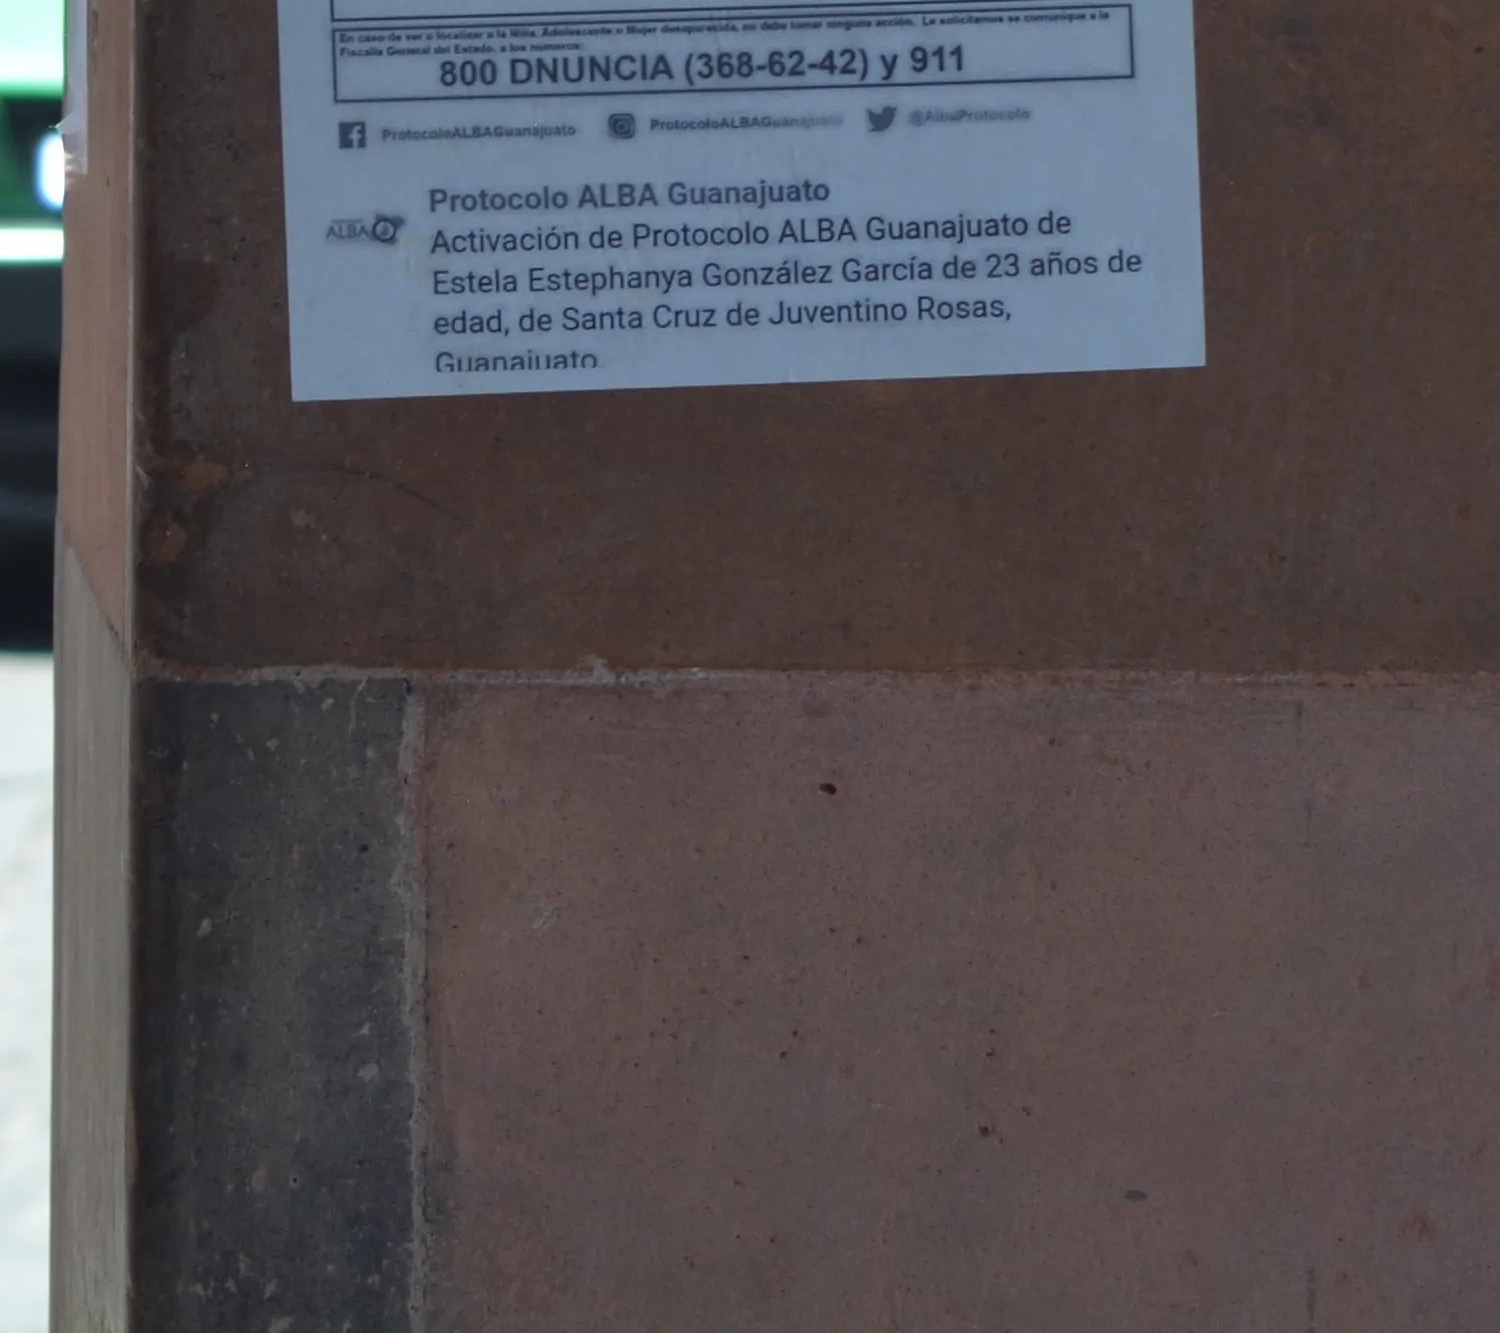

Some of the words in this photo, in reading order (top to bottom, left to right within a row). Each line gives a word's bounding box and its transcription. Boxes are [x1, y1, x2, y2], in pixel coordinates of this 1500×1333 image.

[440, 59, 498, 87] 800
[510, 55, 675, 85] DNUNCIA
[684, 49, 869, 84] (368-62-42)
[880, 53, 899, 80] y
[910, 45, 963, 73] 911
[429, 187, 569, 213] Protocolo
[577, 183, 659, 209] ALBA
[667, 180, 831, 209] Guanajuato
[430, 227, 580, 254] Activación
[588, 225, 624, 250] de
[633, 221, 770, 248] Protocolo
[778, 217, 858, 244] ALBA
[866, 214, 1030, 244] Guanajuato
[1037, 210, 1072, 236] de
[433, 269, 518, 296] Estela
[528, 266, 693, 296] Estephanya
[702, 260, 833, 287] González
[841, 256, 934, 283] García
[942, 255, 977, 280] de
[985, 253, 1021, 279] 23
[1030, 251, 1099, 277] años
[1108, 249, 1143, 274] de
[433, 309, 510, 336] edad,
[518, 308, 553, 333] de
[561, 307, 644, 331] Santa
[653, 304, 718, 329] Cruz
[726, 302, 761, 327] de
[768, 299, 908, 325] Juventino
[917, 296, 1012, 321] Rosas,
